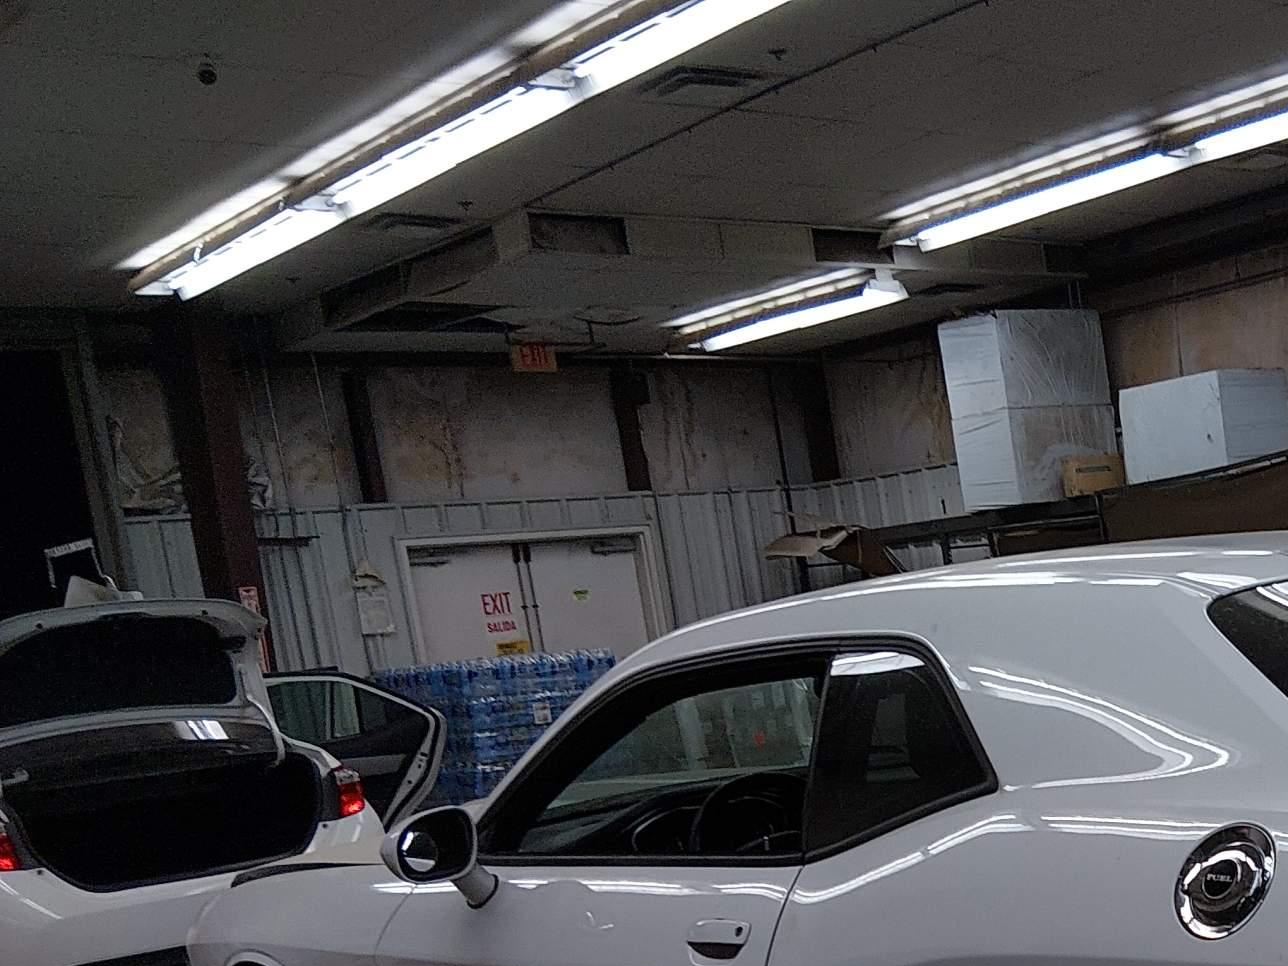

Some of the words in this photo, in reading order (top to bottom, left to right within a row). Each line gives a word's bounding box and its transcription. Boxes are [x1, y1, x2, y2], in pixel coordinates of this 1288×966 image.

[481, 592, 511, 615] EXIT
[487, 620, 517, 633] SALIDA
[1207, 874, 1232, 882] FUEL
